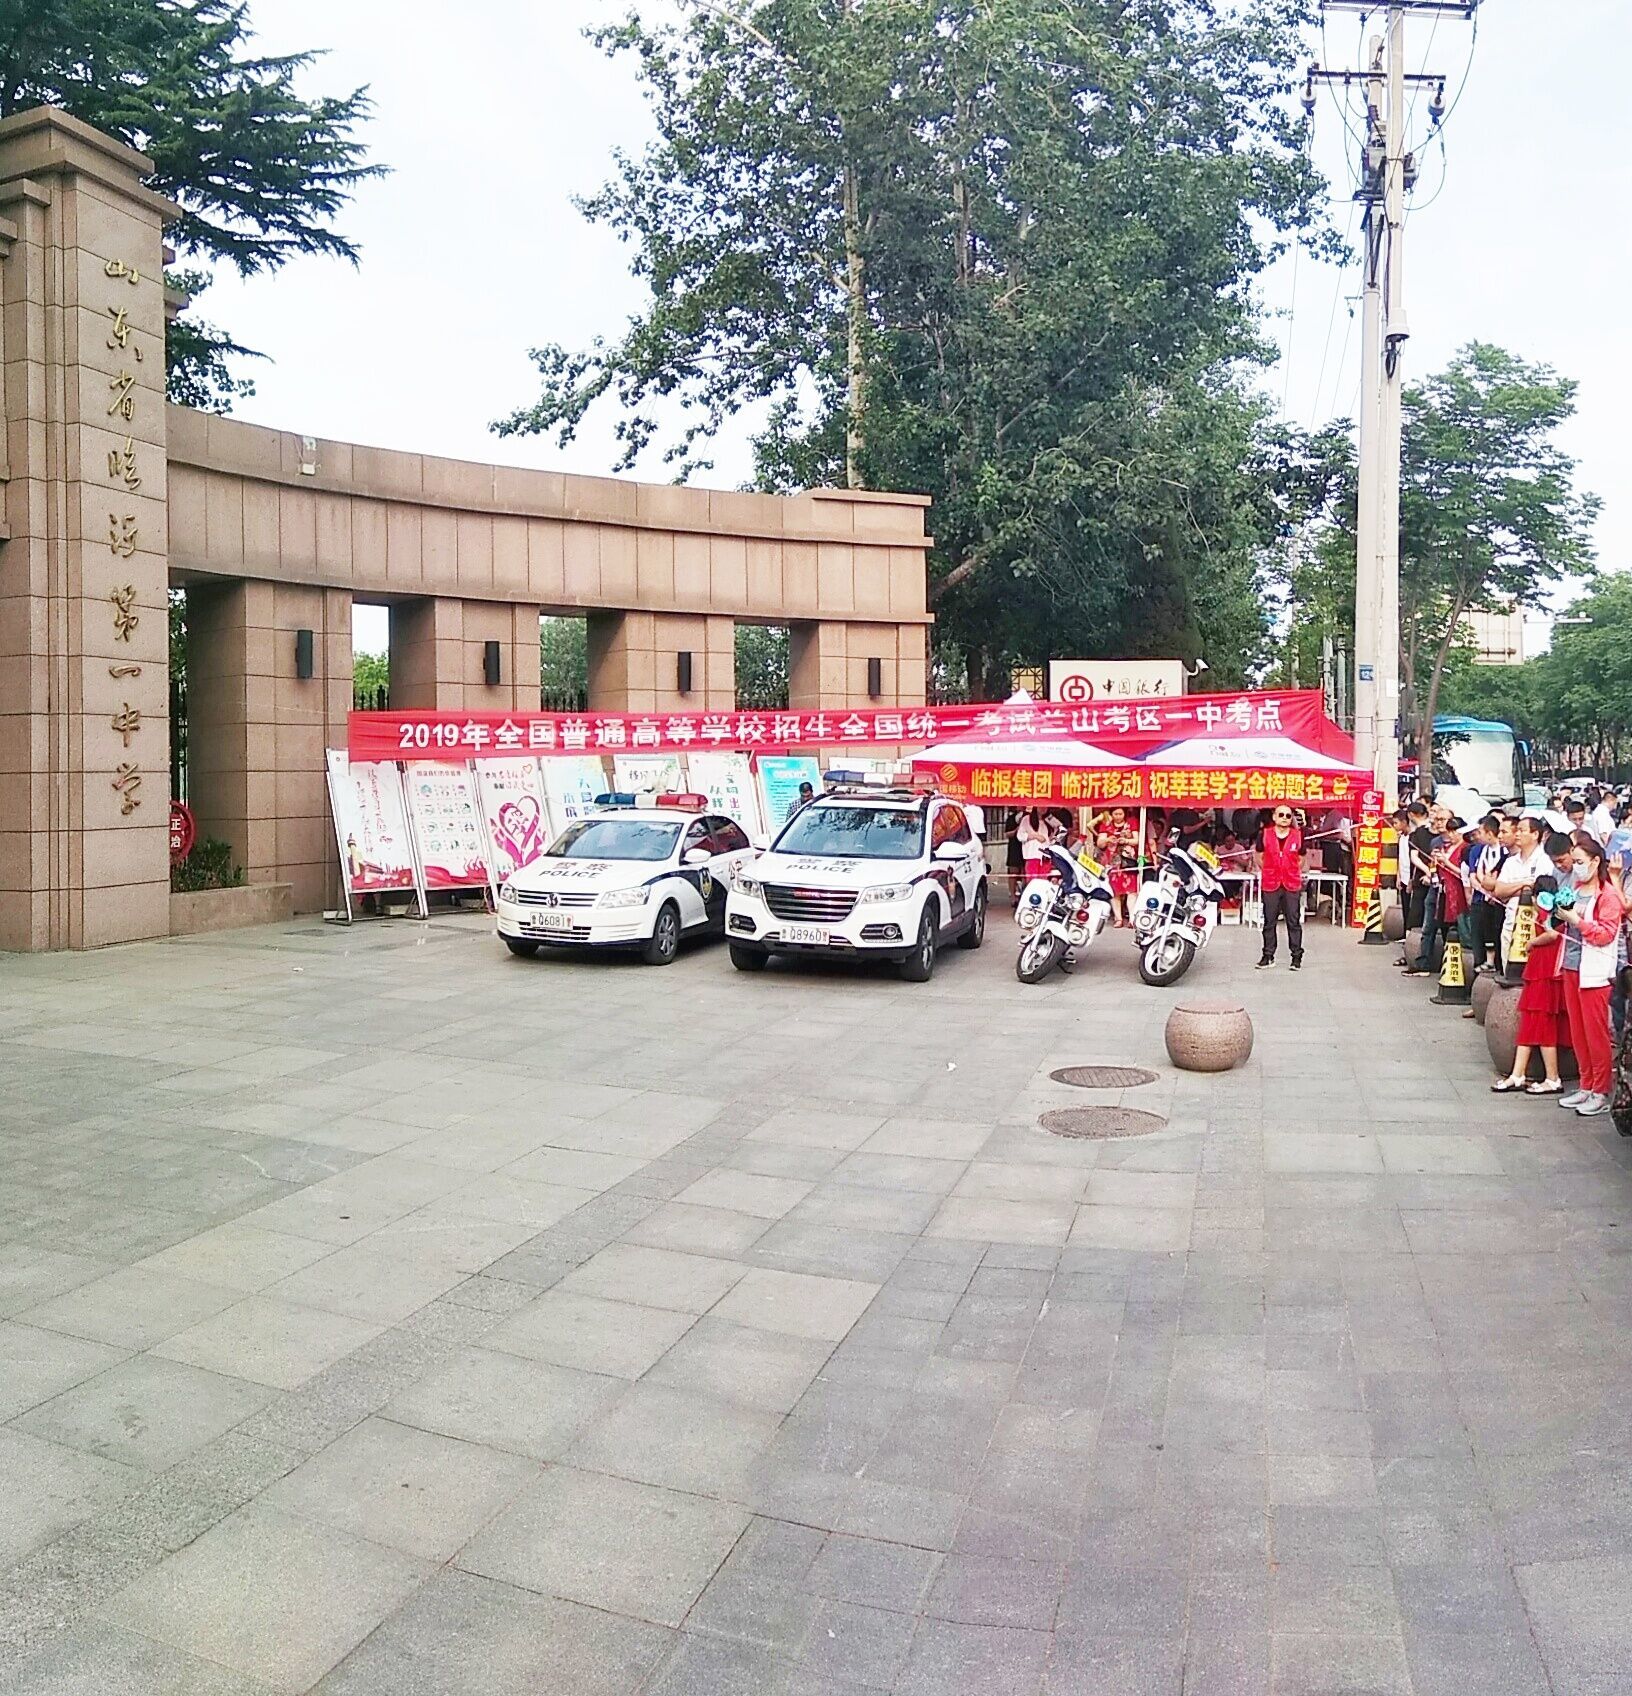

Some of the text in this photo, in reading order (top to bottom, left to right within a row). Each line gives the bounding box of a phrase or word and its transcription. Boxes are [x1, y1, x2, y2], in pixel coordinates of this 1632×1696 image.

[971, 768, 1325, 802] 临报集团 临沂移动 祝莘莘学子金榜题名
[787, 864, 854, 874] POLICE
[539, 870, 602, 879] POLICE
